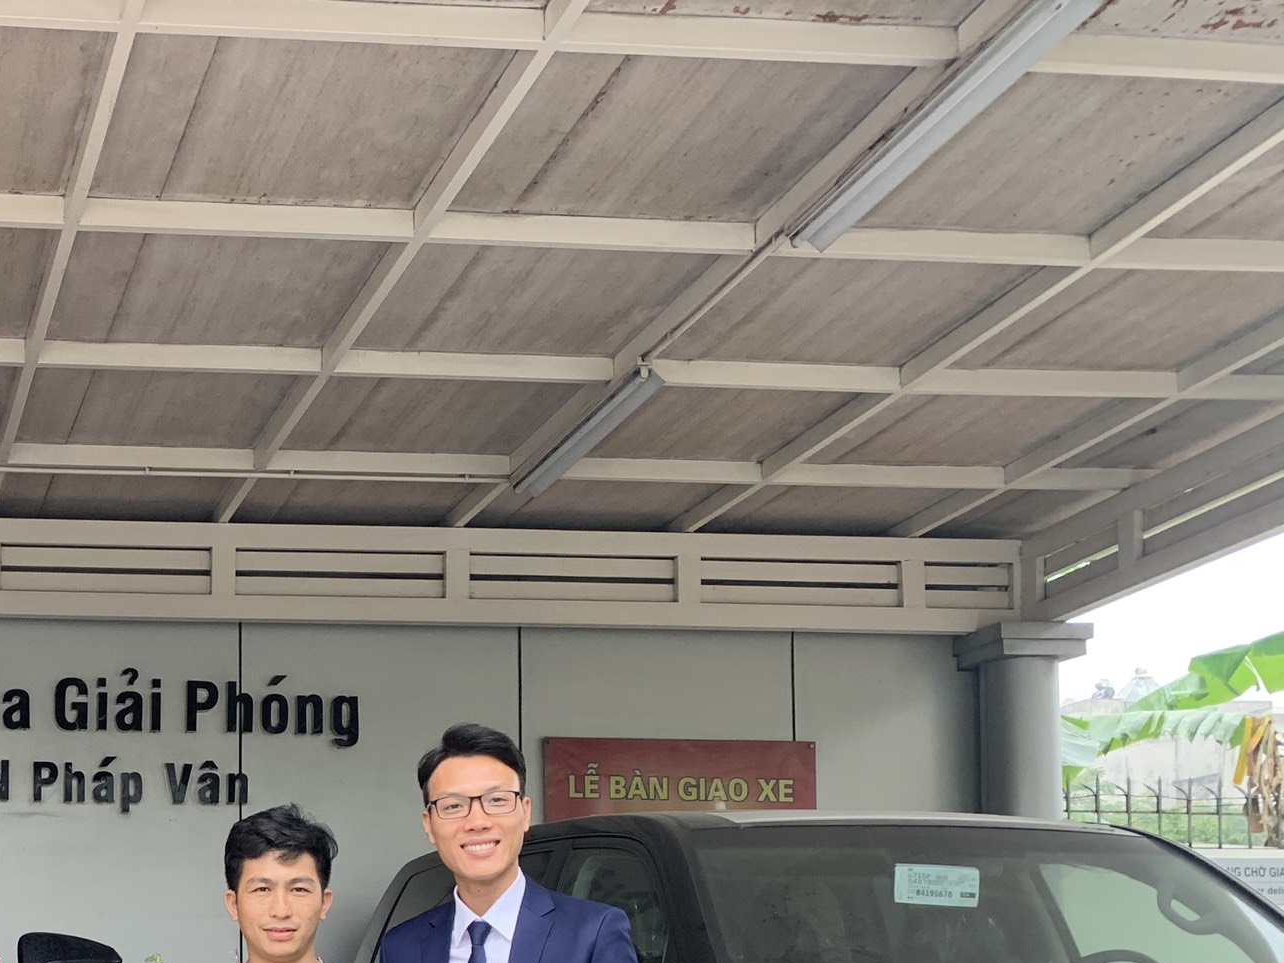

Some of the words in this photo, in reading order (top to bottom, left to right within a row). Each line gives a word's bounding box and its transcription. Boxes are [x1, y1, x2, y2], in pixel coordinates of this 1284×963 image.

[54, 668, 162, 733] Giải
[185, 674, 359, 748] Phóng
[33, 755, 143, 813] Pháp
[164, 760, 249, 805] Vân
[568, 762, 601, 799] LỄ
[609, 770, 668, 801] BÀN
[677, 777, 749, 803] GIAO
[757, 778, 794, 803] XE
